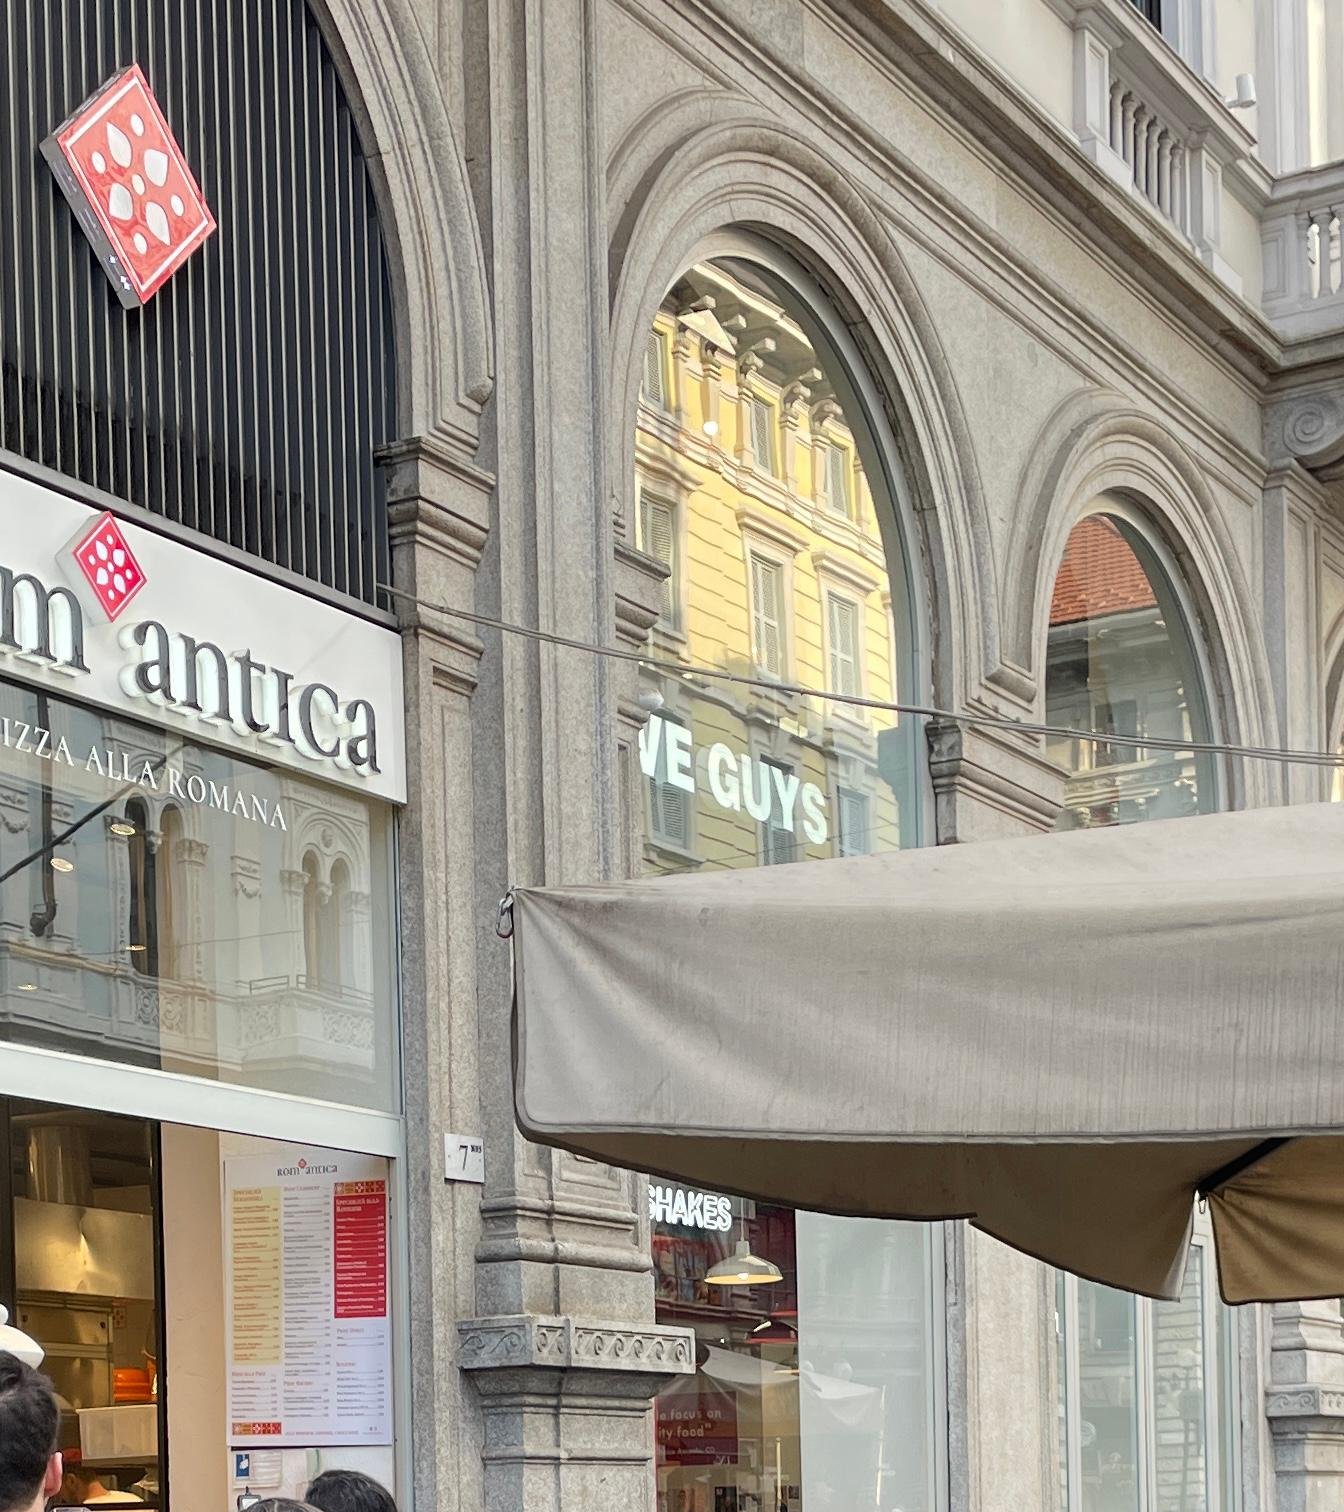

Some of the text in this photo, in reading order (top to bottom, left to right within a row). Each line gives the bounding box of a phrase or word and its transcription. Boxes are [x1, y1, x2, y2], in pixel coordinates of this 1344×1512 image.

[85, 745, 158, 790] ALLA
[168, 767, 288, 832] ROMANA
[708, 742, 828, 845] GUYS
[459, 1144, 468, 1171] 7
